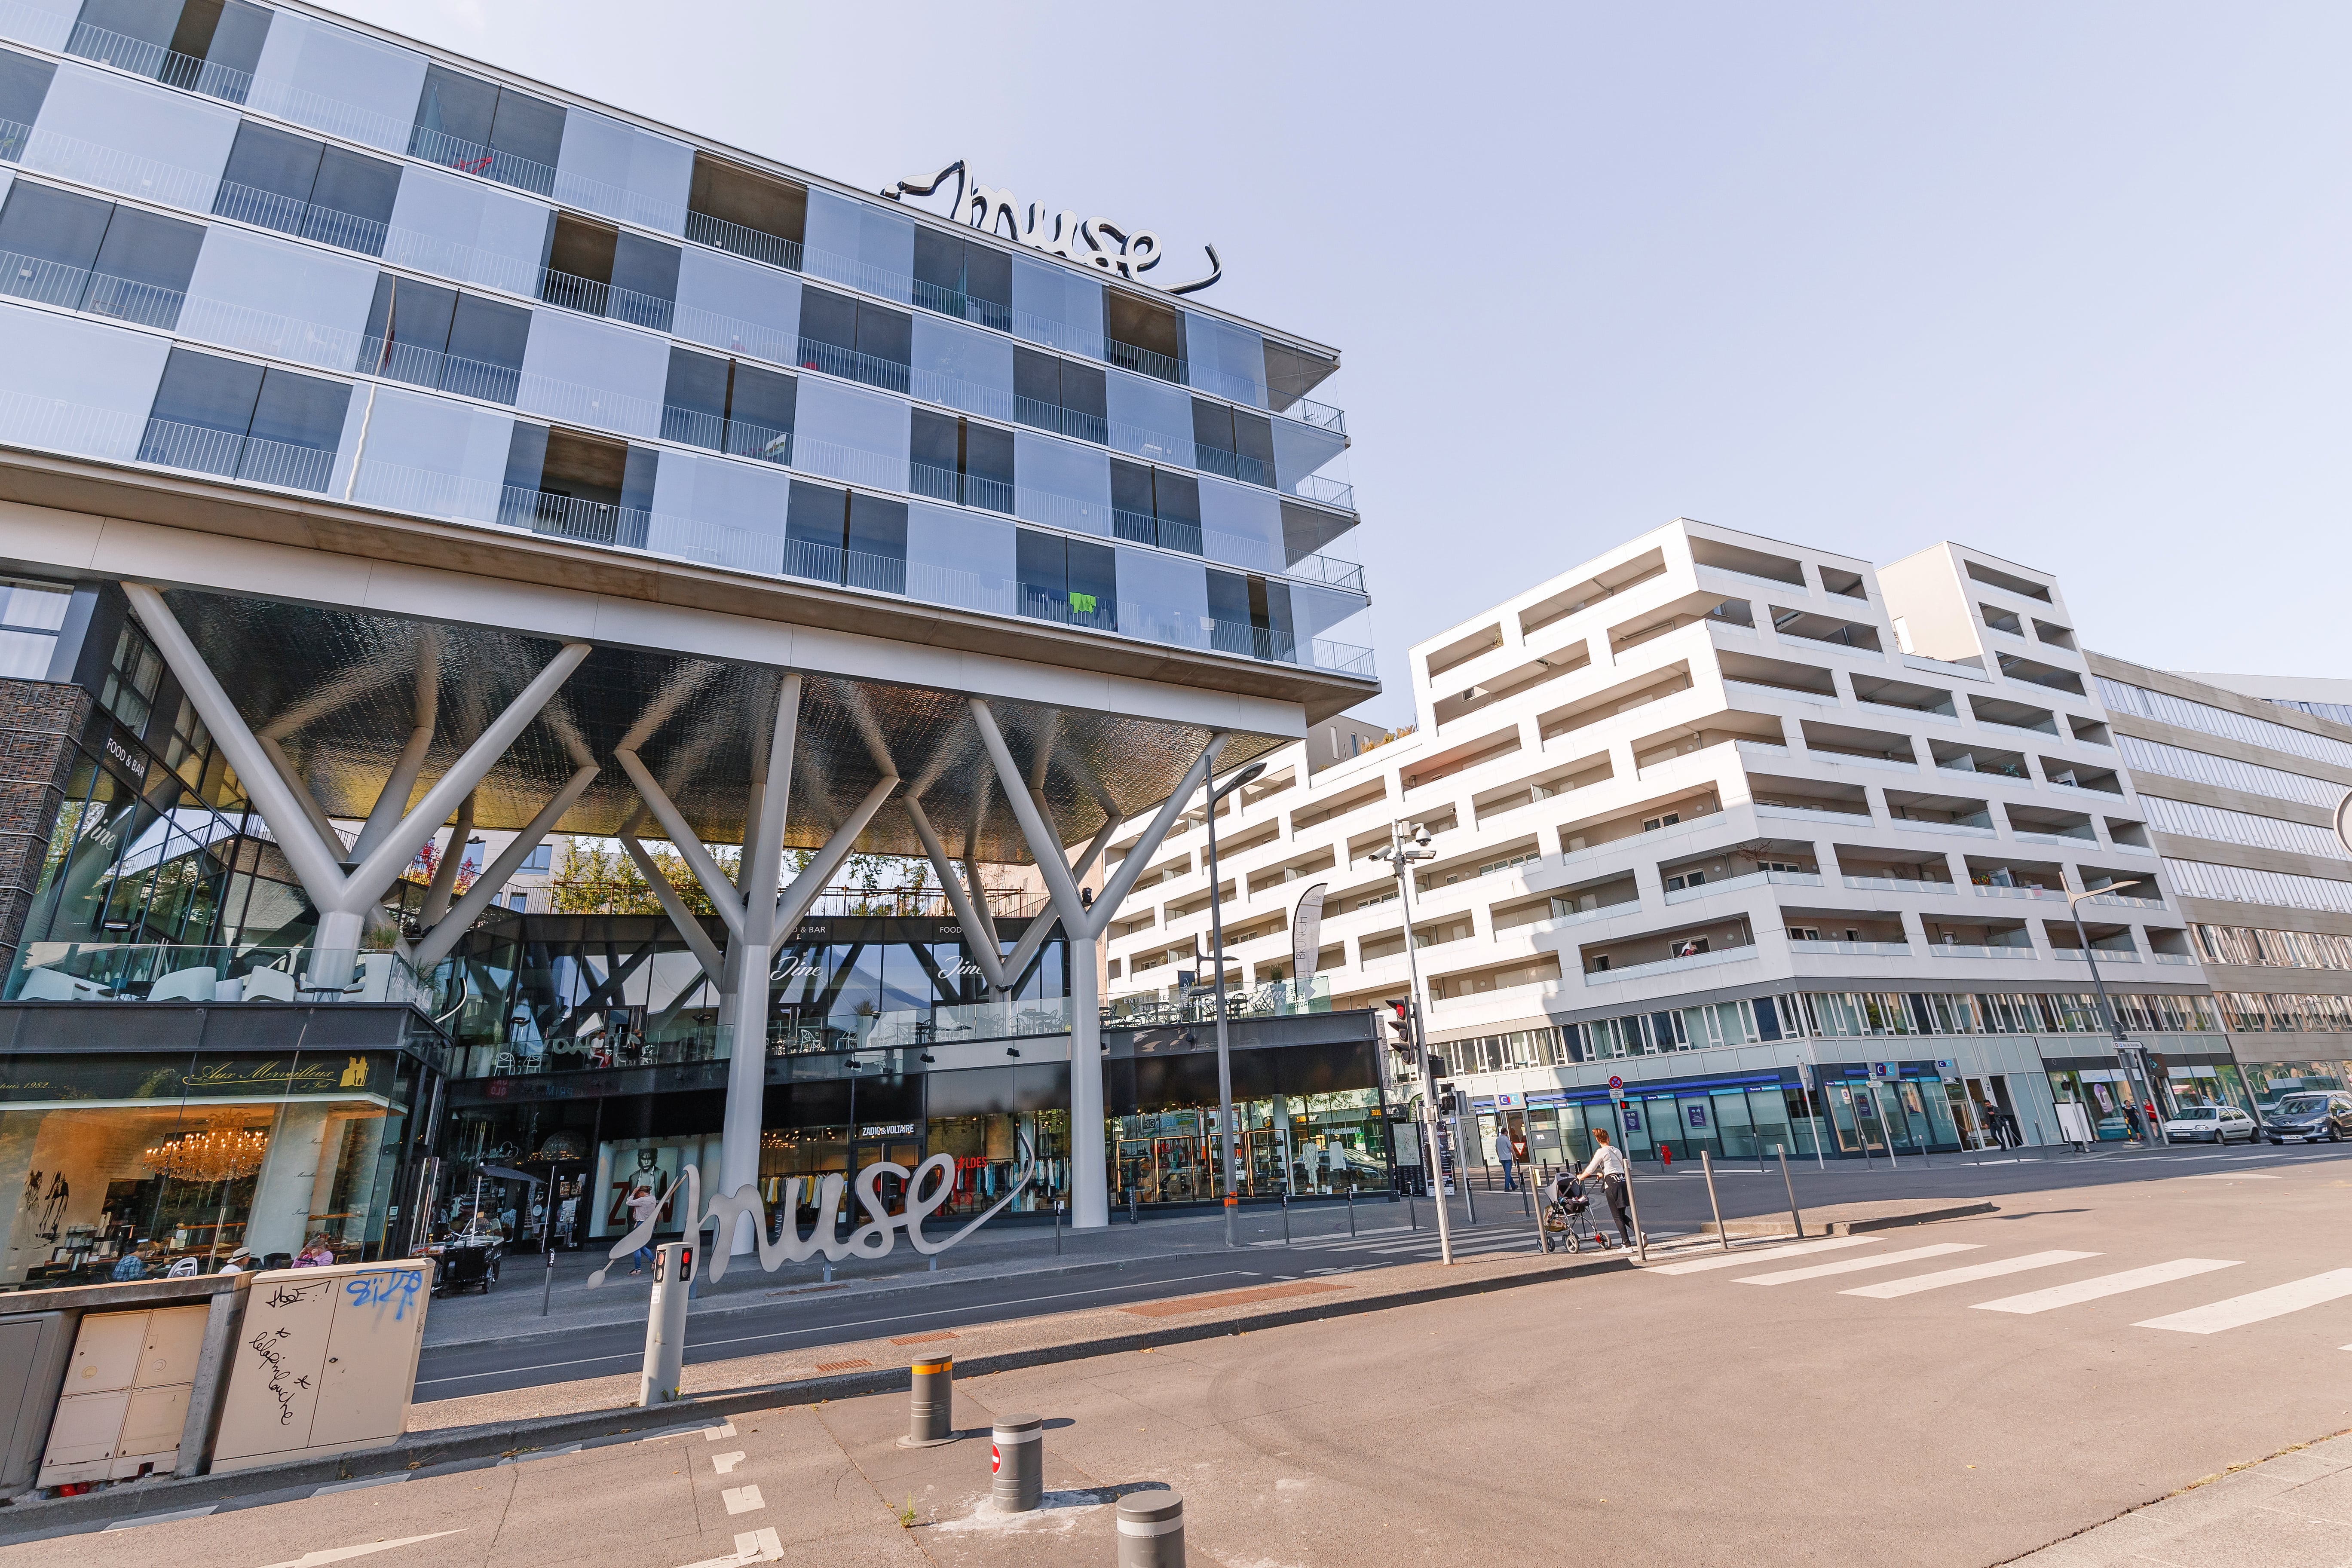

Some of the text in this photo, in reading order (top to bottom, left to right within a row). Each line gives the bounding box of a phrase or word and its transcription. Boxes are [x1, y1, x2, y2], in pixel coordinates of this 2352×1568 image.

[107, 738, 145, 778] FOOD & BAR
[1295, 916, 1308, 960] BRUNCH
[770, 956, 823, 980] Jine
[1377, 1017, 1389, 1075] RESTAURANTS
[192, 1060, 334, 1080] Aux Merveilleux
[1877, 1065, 1893, 1074] CIC
[1501, 1095, 1518, 1104] CIC
[862, 1124, 914, 1136] ZADIG&VOLTAIRE
